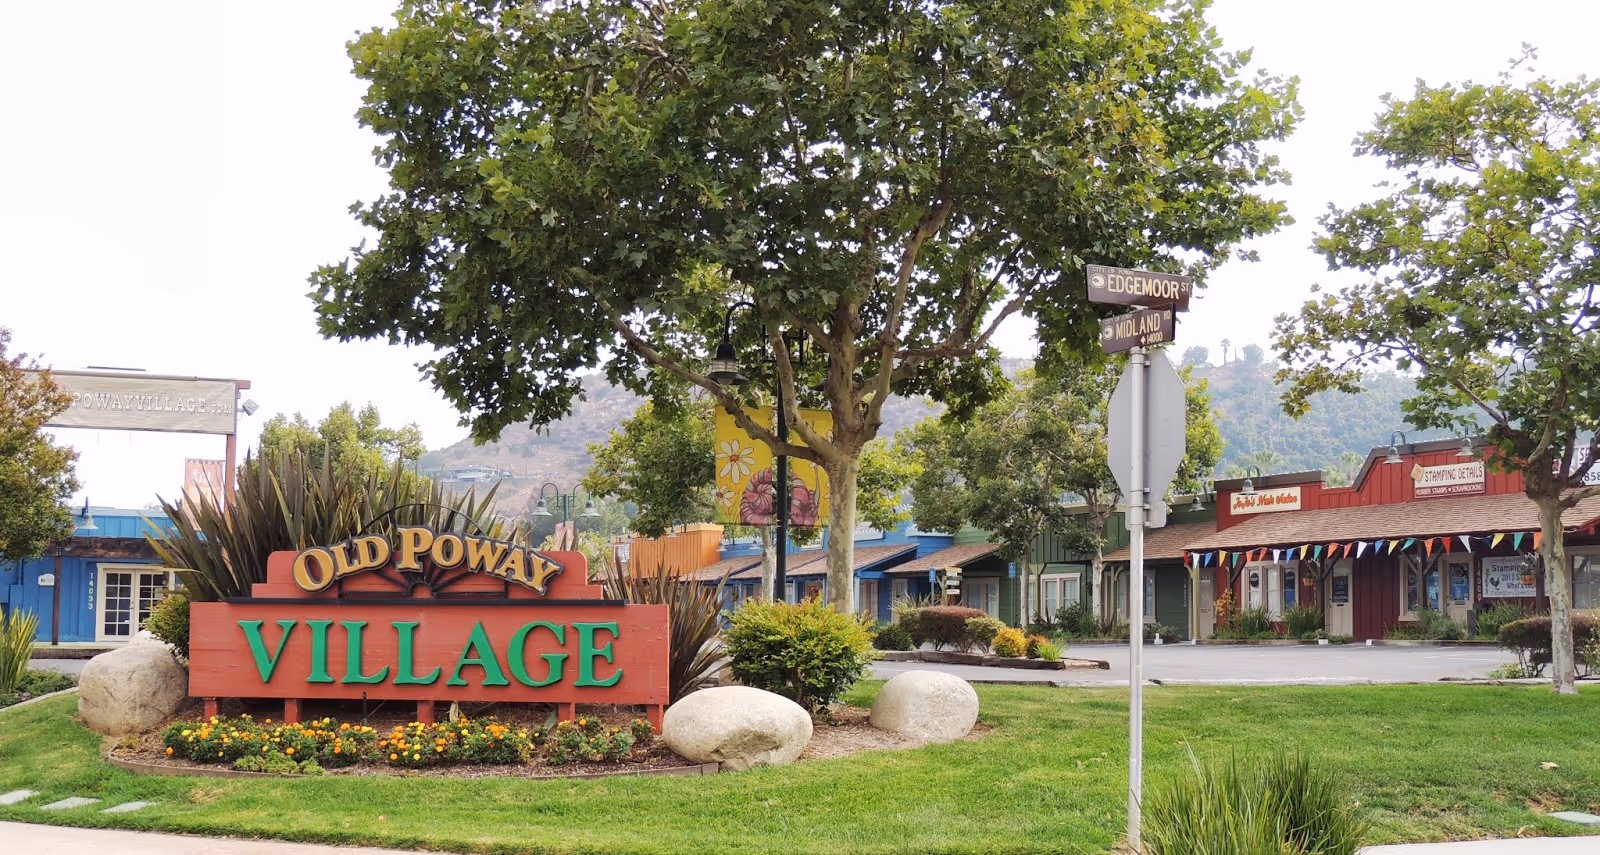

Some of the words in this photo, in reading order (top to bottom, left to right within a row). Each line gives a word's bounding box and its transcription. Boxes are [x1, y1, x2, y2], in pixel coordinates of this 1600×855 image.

[1107, 274, 1180, 299] EDGEMOOR
[1180, 282, 1190, 293] ST
[1115, 313, 1160, 340] MIDLAND
[1163, 310, 1171, 320] RD
[1147, 331, 1163, 344] 14000
[1425, 468, 1456, 483] STAMPING
[1458, 465, 1483, 480] DETAILS
[1416, 487, 1432, 495] RUBBER
[1432, 486, 1448, 494] STAMPS
[1451, 483, 1484, 493] SCRAPBOOKING
[1501, 573, 1515, 582] 2013
[237, 619, 624, 688] VILLAGE
